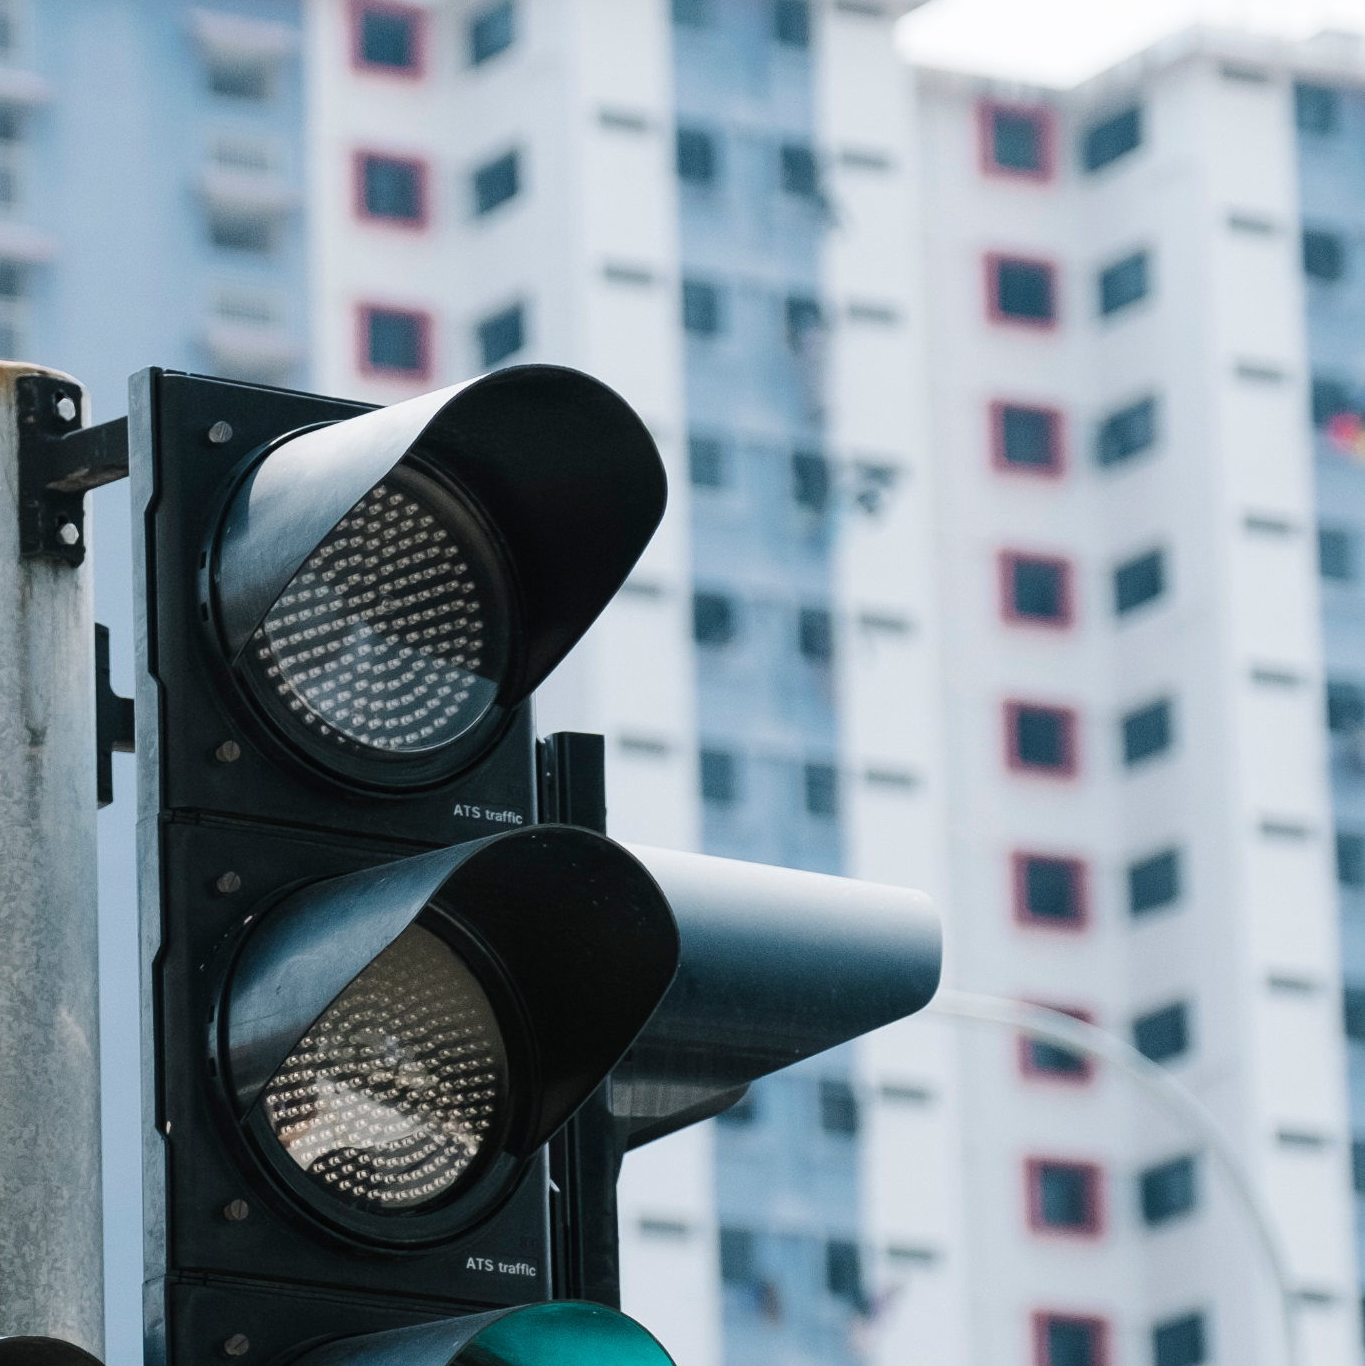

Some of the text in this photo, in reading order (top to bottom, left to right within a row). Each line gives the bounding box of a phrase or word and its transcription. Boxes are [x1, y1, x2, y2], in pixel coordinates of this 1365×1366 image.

[453, 803, 523, 825] ATS traffic
[466, 1256, 537, 1277] ATS traffic
